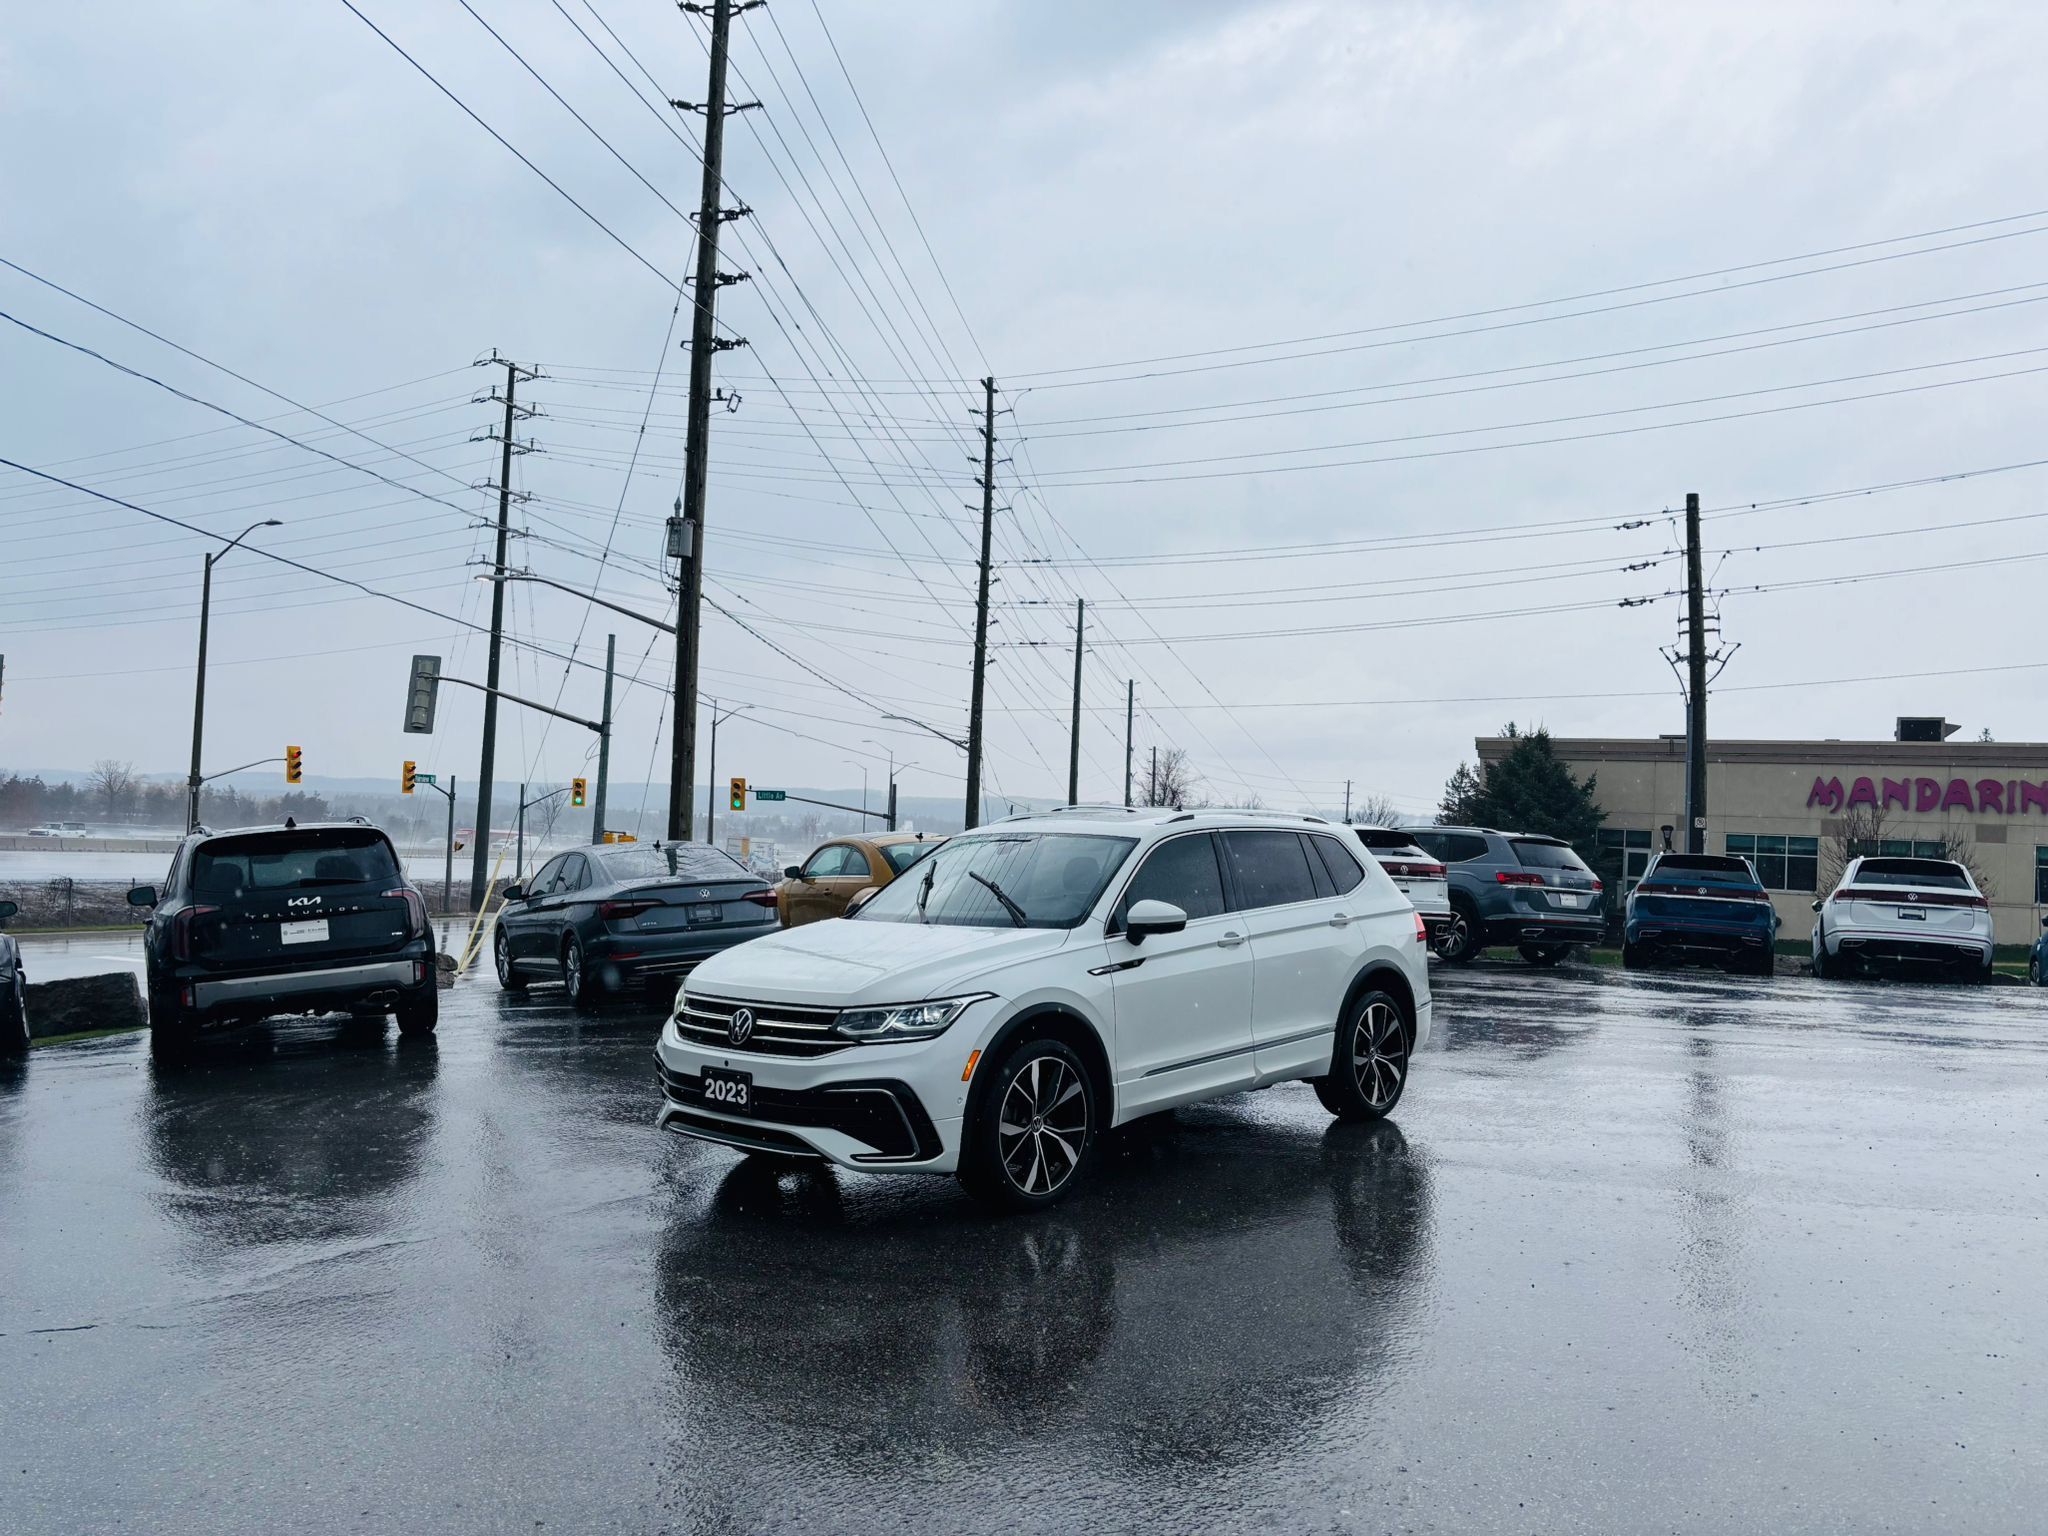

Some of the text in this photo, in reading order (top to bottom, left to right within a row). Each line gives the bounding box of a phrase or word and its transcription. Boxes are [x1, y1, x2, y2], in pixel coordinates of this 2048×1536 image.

[758, 791, 774, 800] Little
[1806, 775, 2048, 815] MANDARIN
[287, 896, 322, 907] KIA
[249, 905, 360, 920] TELLURIDE
[705, 1078, 747, 1104] 2023
